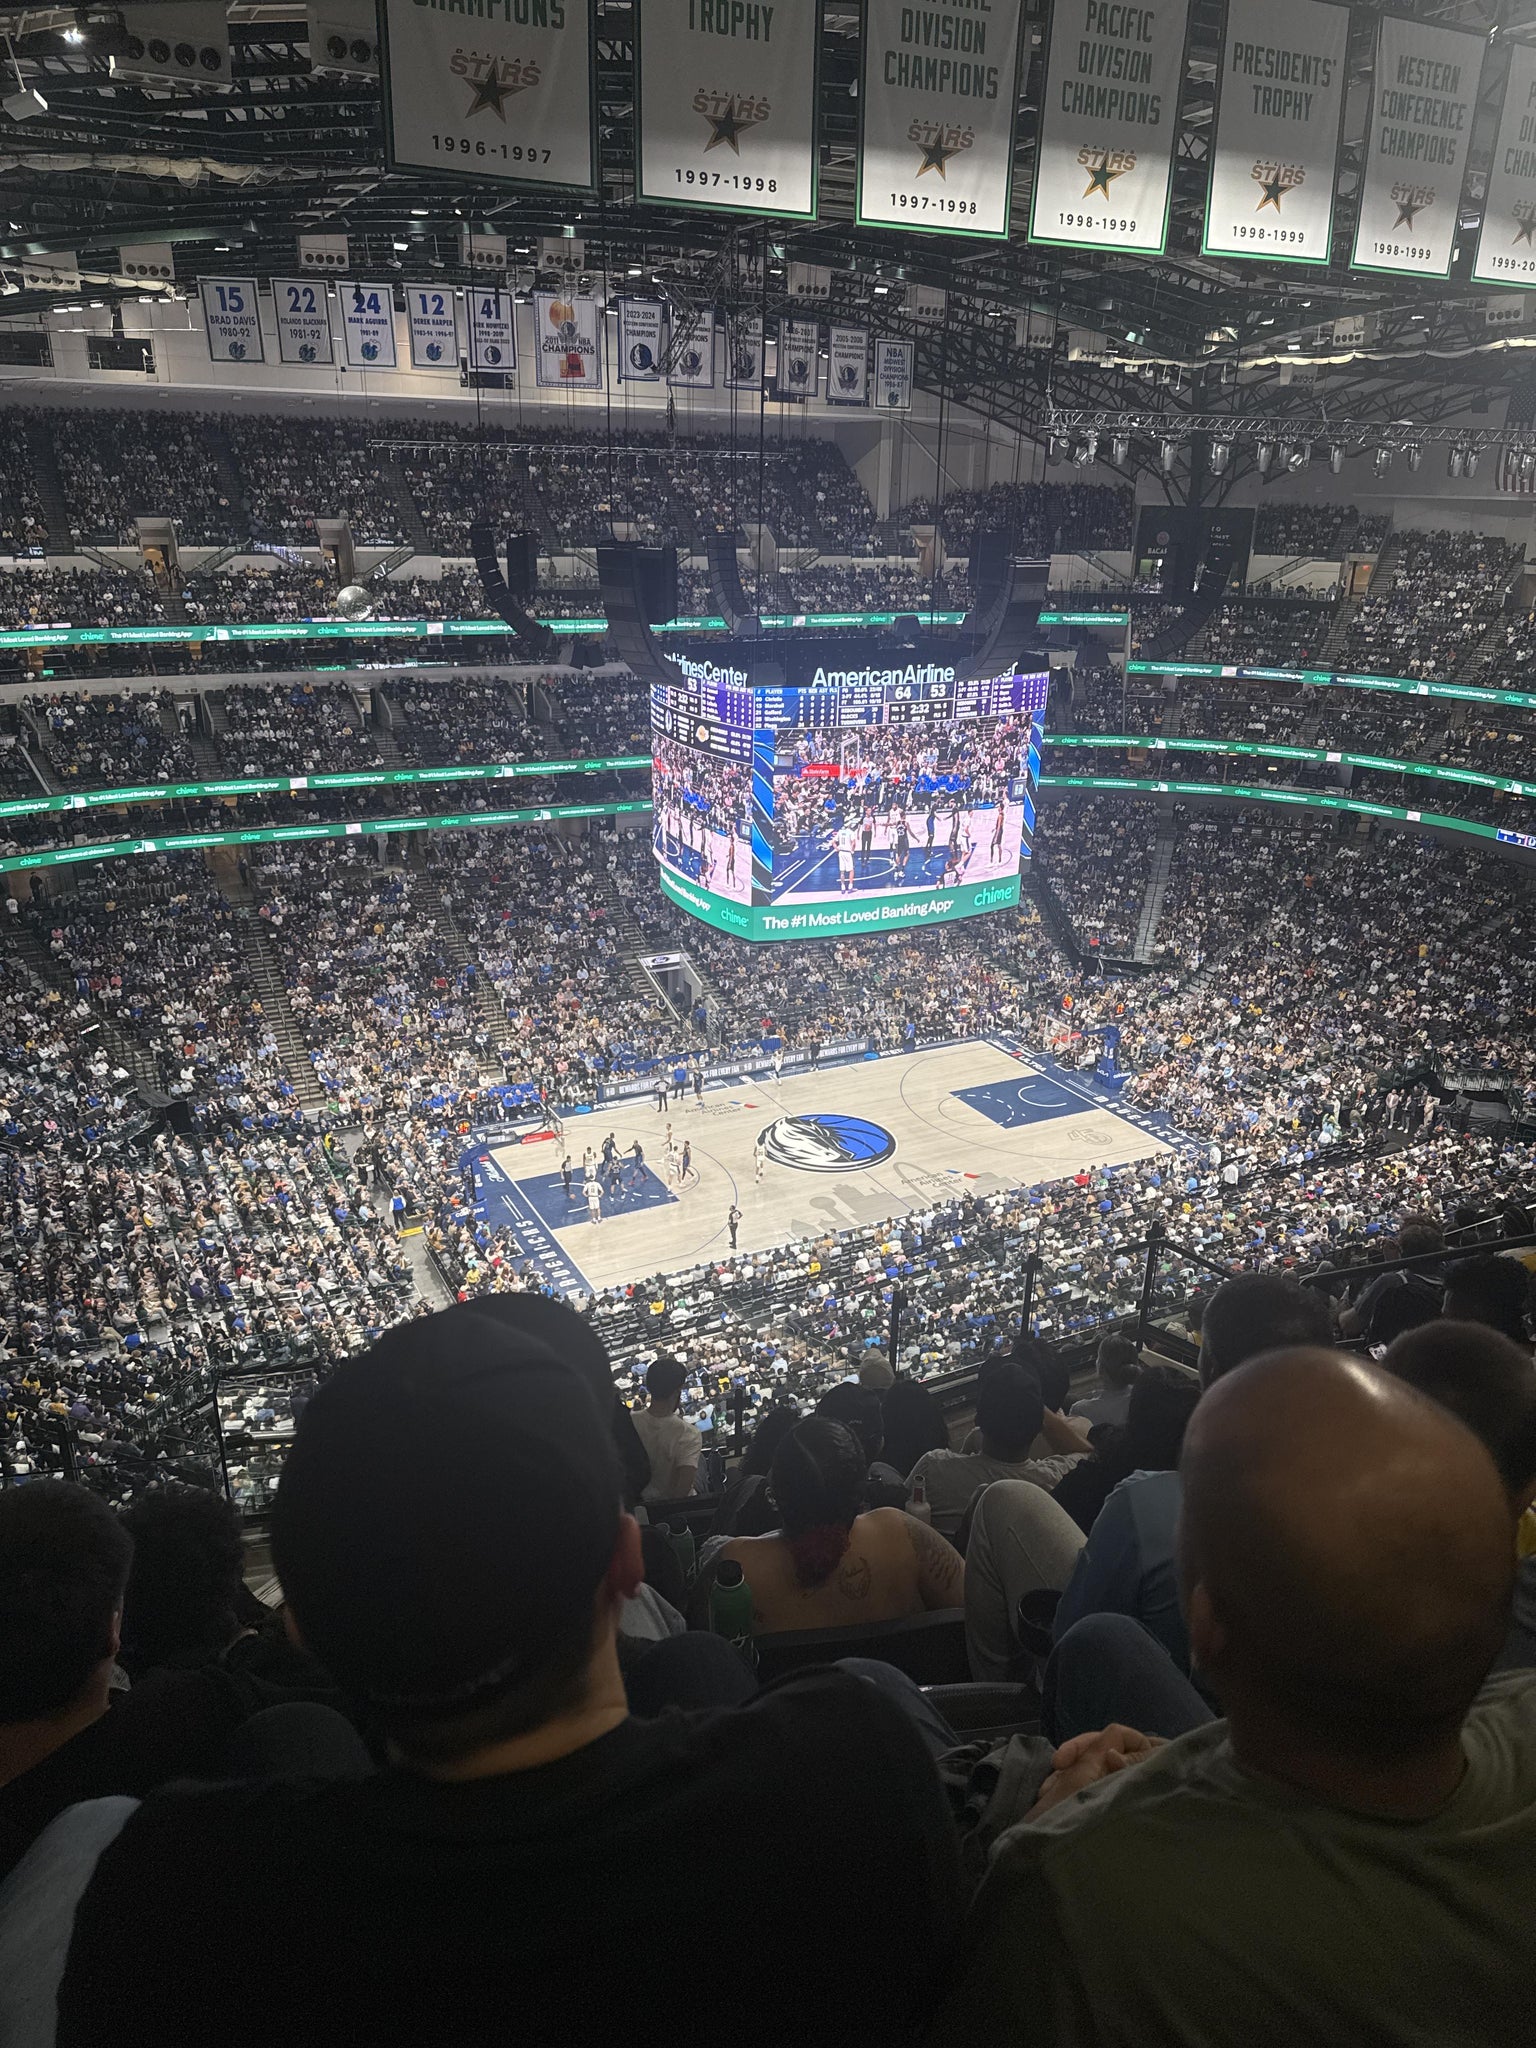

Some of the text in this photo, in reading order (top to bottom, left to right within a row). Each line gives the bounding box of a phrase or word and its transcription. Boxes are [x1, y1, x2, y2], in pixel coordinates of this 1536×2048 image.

[689, 0, 774, 42] TROPHY
[901, 8, 986, 54] DIVISION
[1085, 0, 1155, 43] PACIFIC
[455, 47, 537, 66] DALLAS
[1078, 40, 1152, 84] DIVISION
[1233, 41, 1337, 88] PRESIDENTS'
[450, 53, 541, 87] STARS
[884, 51, 998, 100] CHAMPIONS
[1397, 54, 1461, 94] WESTERN
[692, 93, 772, 121] STARS
[1061, 81, 1161, 125] CHAMPIONS
[1253, 84, 1313, 122] TROPHY
[1380, 89, 1467, 132] CONFERENCE
[907, 123, 975, 149] STARS
[1380, 126, 1456, 166] CHAMPIONS
[432, 135, 552, 165] 1996-1997
[1077, 148, 1138, 172] STARS
[675, 168, 778, 194] 1997-1998
[1250, 164, 1306, 185] STARS
[890, 193, 977, 215] 1997-1998
[1390, 185, 1436, 206] STARS
[1059, 212, 1137, 232] 1998-1999
[1232, 226, 1305, 244] 1998-1999
[1373, 242, 1431, 260] 1998-1999
[216, 286, 244, 313] 15
[287, 286, 316, 313] 22
[353, 292, 381, 314] 24
[419, 293, 445, 315] 12
[480, 298, 501, 320] 41
[210, 315, 256, 326] BRAD DAVIS
[219, 327, 250, 337] 1980-92
[542, 344, 595, 355] CHAMPIONS
[834, 351, 864, 360] CHAMPIONS
[886, 347, 903, 358] NBA
[687, 677, 697, 692] 53
[895, 686, 911, 700] 64
[930, 684, 946, 698] 53
[910, 704, 930, 714] 2:32
[974, 887, 1013, 907] chime
[720, 908, 749, 927] chime
[763, 915, 789, 930] The
[791, 914, 808, 928] #1
[809, 913, 842, 927] Most
[843, 911, 880, 924] Loved
[881, 905, 928, 921] Banking
